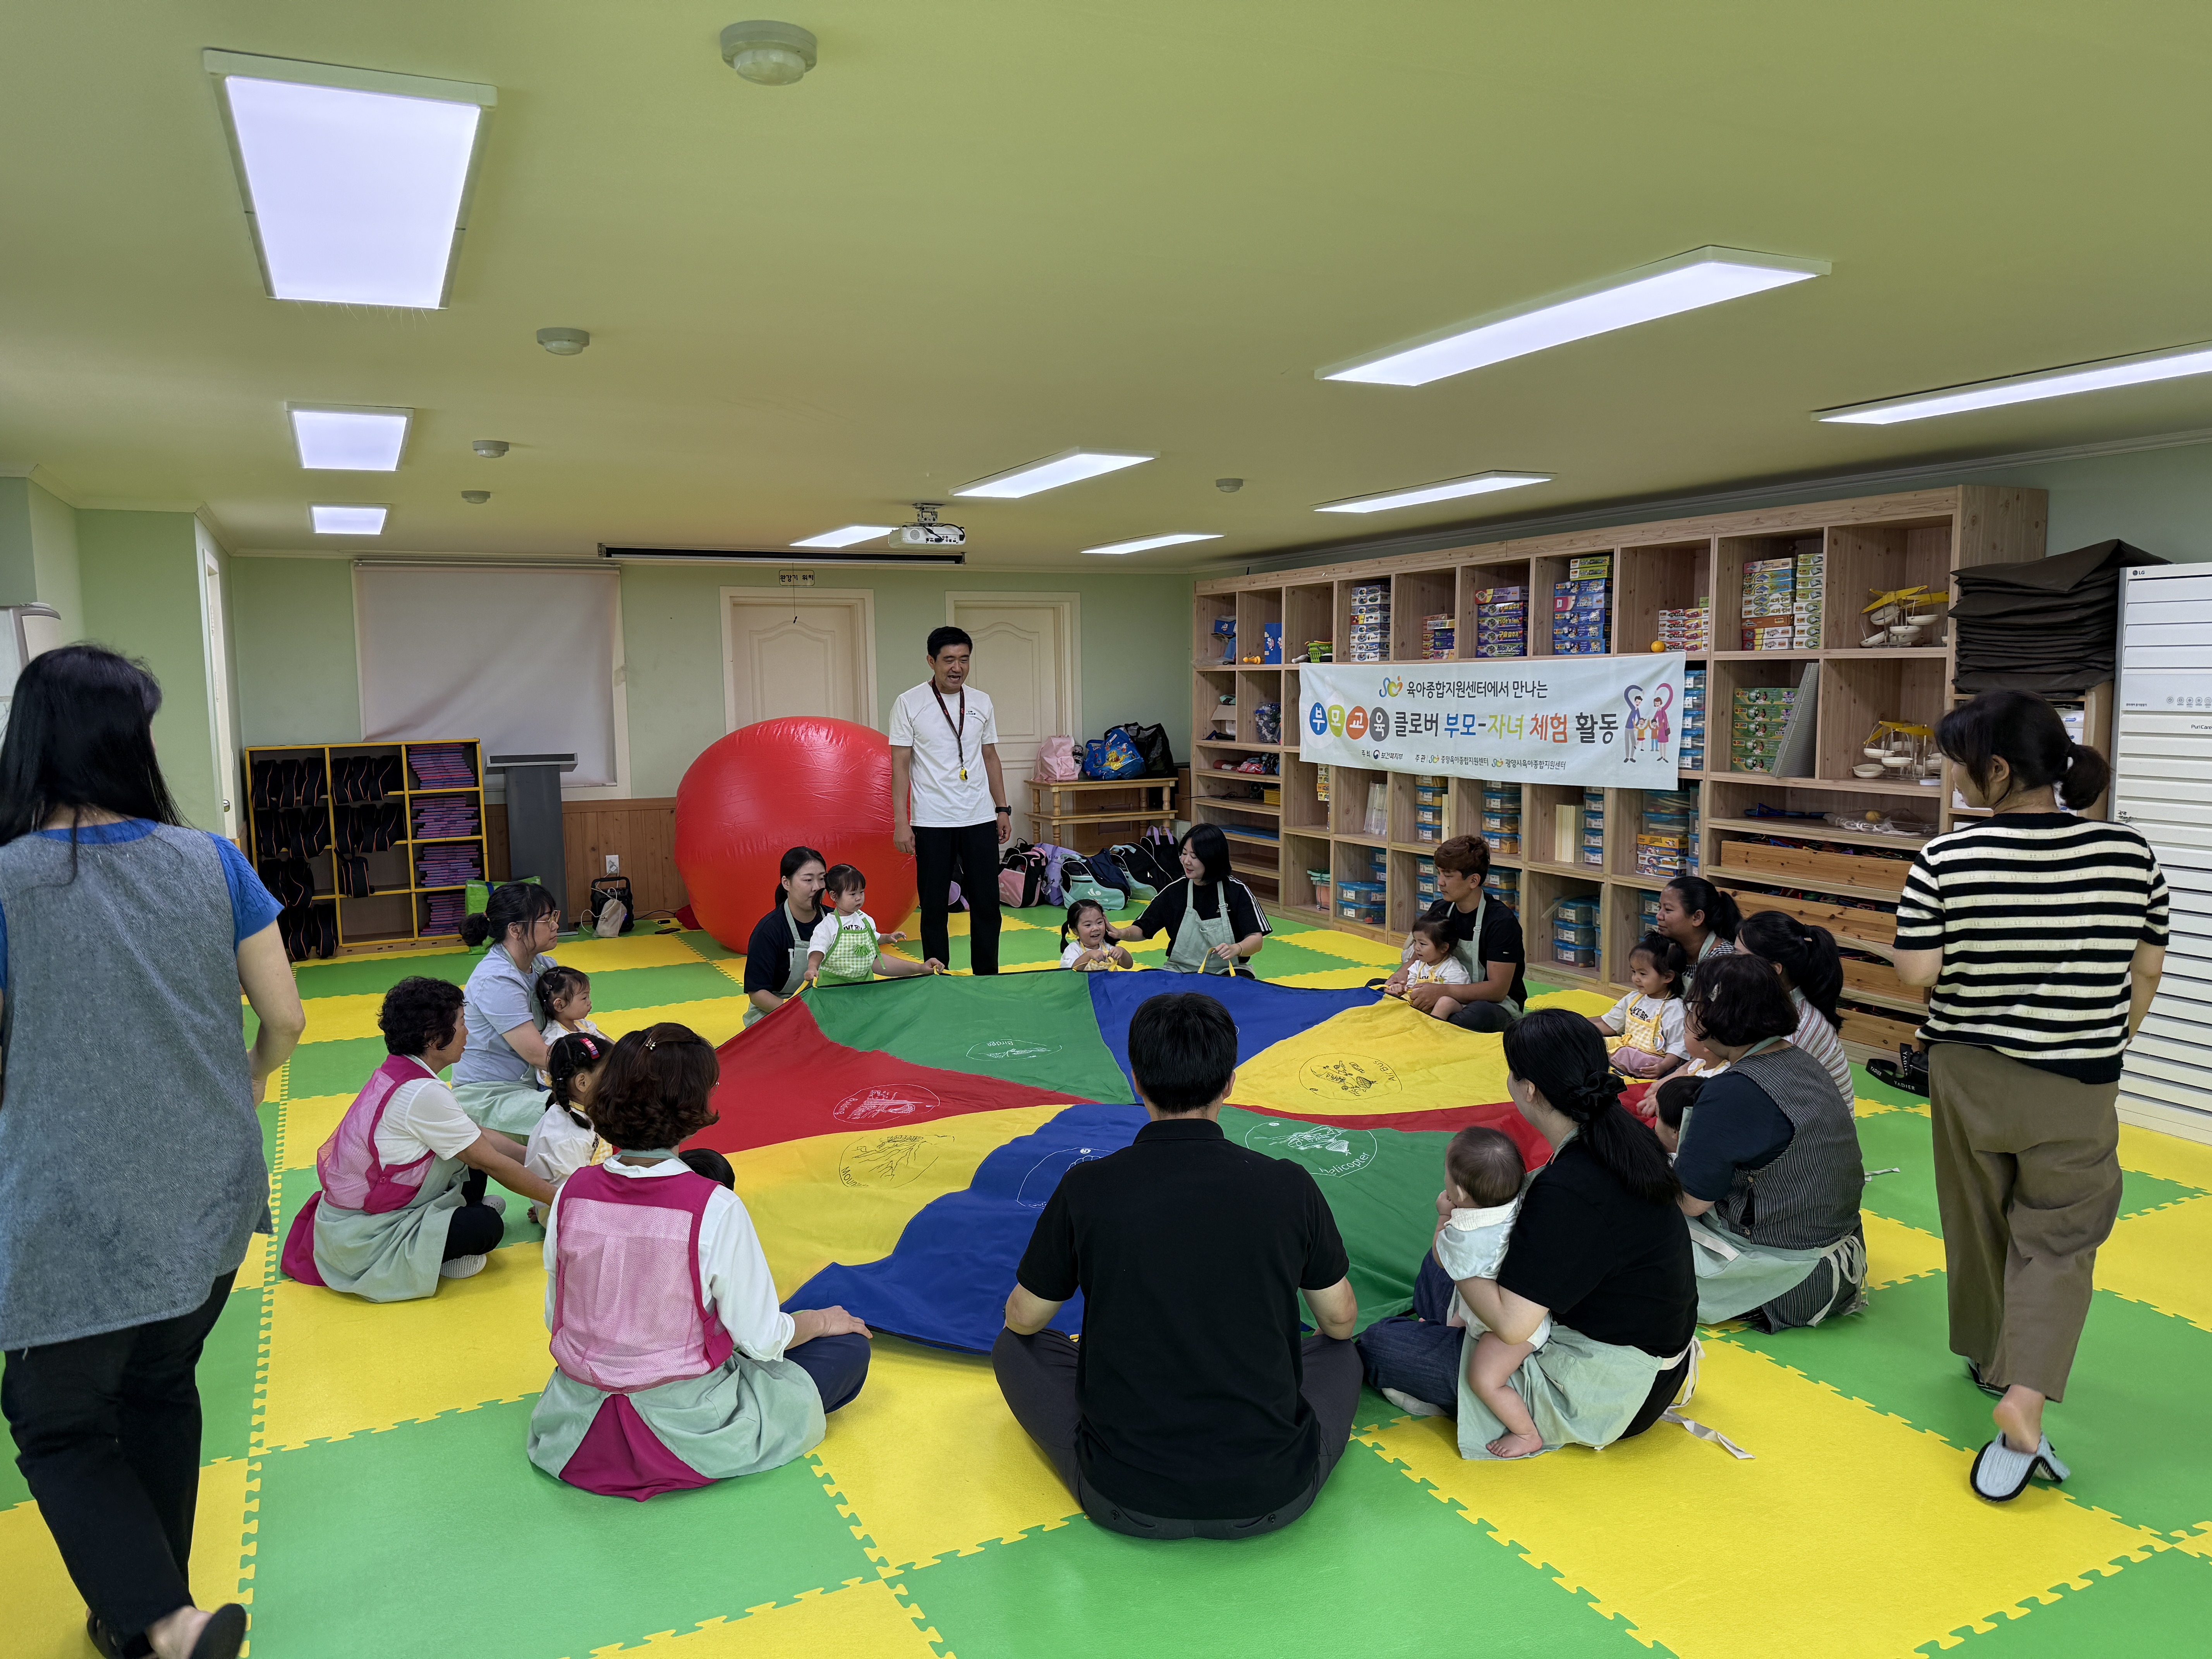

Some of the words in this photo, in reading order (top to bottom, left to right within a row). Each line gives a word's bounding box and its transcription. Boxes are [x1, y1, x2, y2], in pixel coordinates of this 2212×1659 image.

[1407, 680, 1509, 698] 육아종합지원센터에서
[1513, 680, 1548, 698] 만나는
[1312, 707, 1385, 737] 부모교육
[1395, 711, 1439, 737] 클로버
[1444, 713, 1524, 740] 부모-자녀
[1529, 713, 1568, 743] 체험
[1575, 712, 1619, 744] 활동
[1381, 752, 1403, 760] 보건복지부
[1441, 756, 1489, 766] 중앙육아종합지원센터
[1505, 759, 1566, 770] 광양시육아종합지원센터
[1894, 1080, 1915, 1091] YADIER
